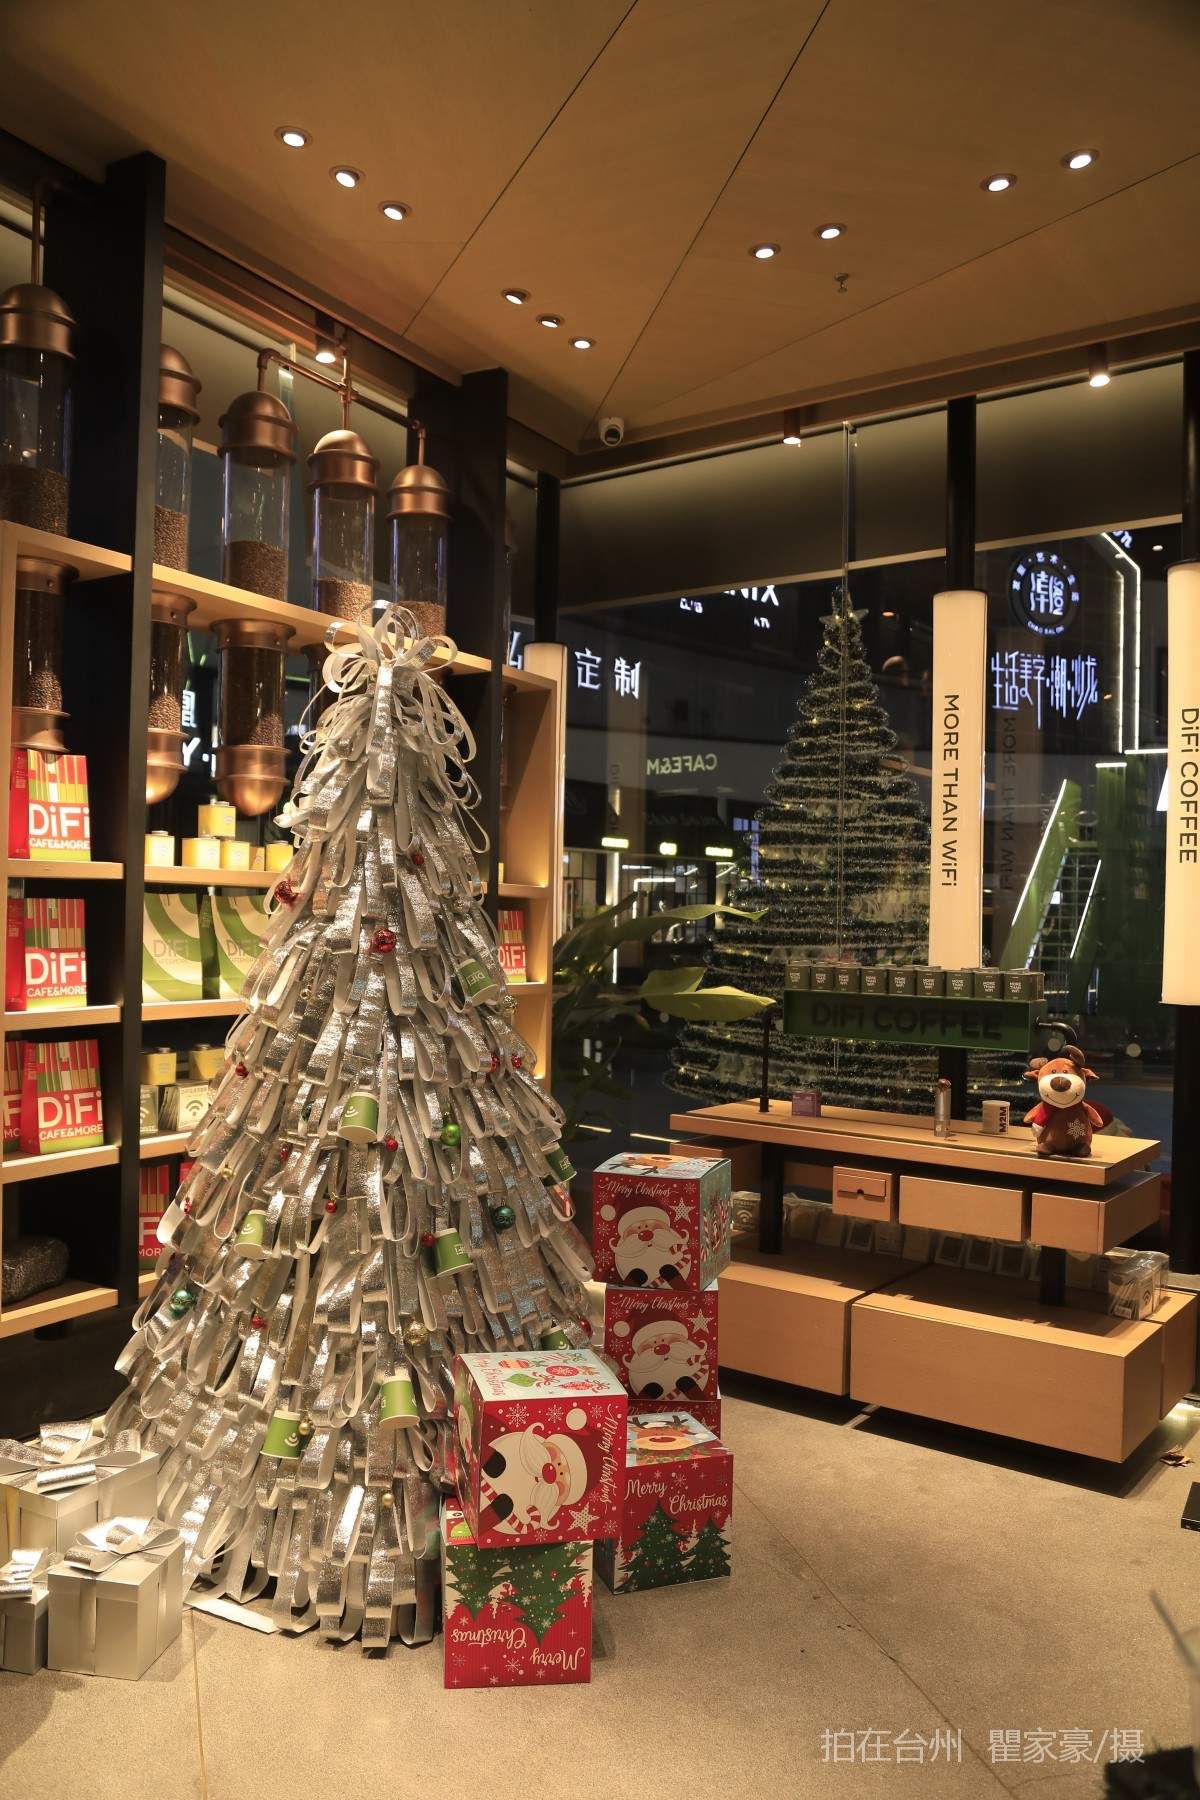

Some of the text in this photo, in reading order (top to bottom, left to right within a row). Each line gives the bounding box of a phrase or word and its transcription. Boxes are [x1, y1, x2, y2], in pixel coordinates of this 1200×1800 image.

[941, 694, 960, 888] MORE THAN WiFi
[1179, 708, 1200, 864] DiFi COFFEE
[28, 803, 90, 838] DiFi
[28, 837, 91, 850] CAFE&MORE
[25, 950, 87, 986] DiFi
[27, 985, 88, 999] CAFE&MORE
[873, 1005, 1003, 1041] COFFEE
[37, 1090, 103, 1129] DiFi
[39, 1122, 104, 1141] CAFE&MORE
[624, 1479, 668, 1500] Merry
[669, 1493, 729, 1514] Christmas
[451, 1627, 527, 1650] Christmas
[530, 1647, 586, 1671] Merry
